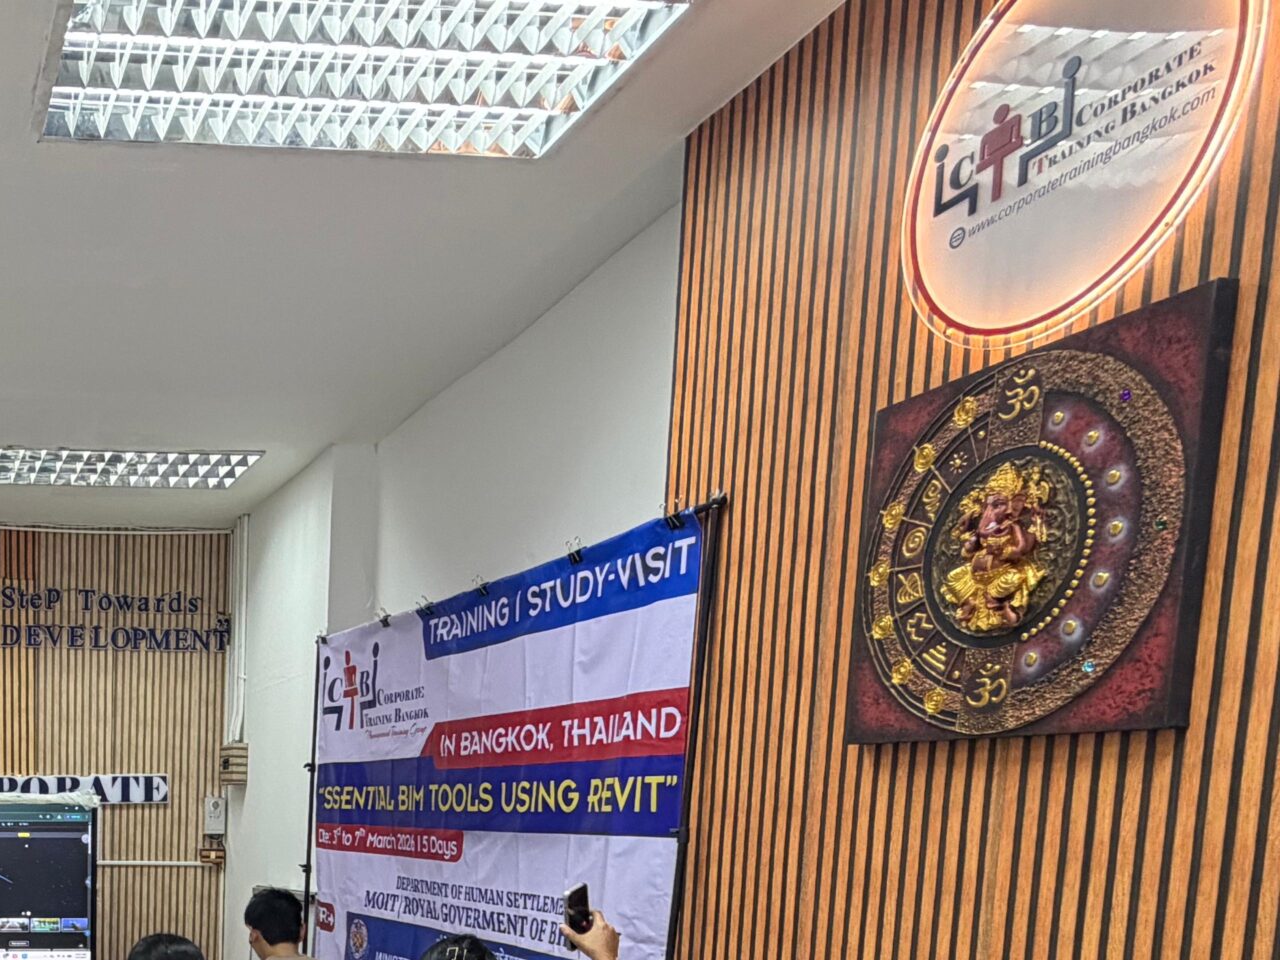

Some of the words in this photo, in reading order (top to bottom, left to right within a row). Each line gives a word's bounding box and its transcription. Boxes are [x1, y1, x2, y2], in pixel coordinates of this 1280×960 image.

[1075, 41, 1202, 127] CORPORATE
[1032, 119, 1116, 177] TRAINING
[1121, 60, 1216, 126] BANGKOK
[967, 86, 1216, 239] www.corporatetrainingbangkok.com
[78, 588, 202, 613] Towards
[429, 597, 509, 645] TRAINING
[526, 536, 697, 617] STUDY-VISIT
[377, 686, 426, 706] CORPORATE
[364, 712, 392, 728] TRAINING
[394, 707, 430, 724] BANGKOK
[440, 734, 456, 757] IN
[460, 722, 554, 756] BANGKOK,
[561, 706, 682, 748] THAILAND
[398, 785, 425, 812] BIM
[429, 782, 494, 813] TOOLS
[501, 779, 580, 814] USING
[342, 829, 353, 847] to
[366, 832, 397, 850] March
[397, 833, 416, 852] 2026
[422, 836, 429, 853] 5
[429, 835, 458, 860] Days
[396, 875, 449, 898] DEPARTMENT
[451, 884, 464, 901] OF
[464, 887, 504, 908] HUMAN
[505, 891, 565, 915] SETTLEME
[440, 903, 528, 938] GOVERMENT
[529, 917, 548, 941] OF
